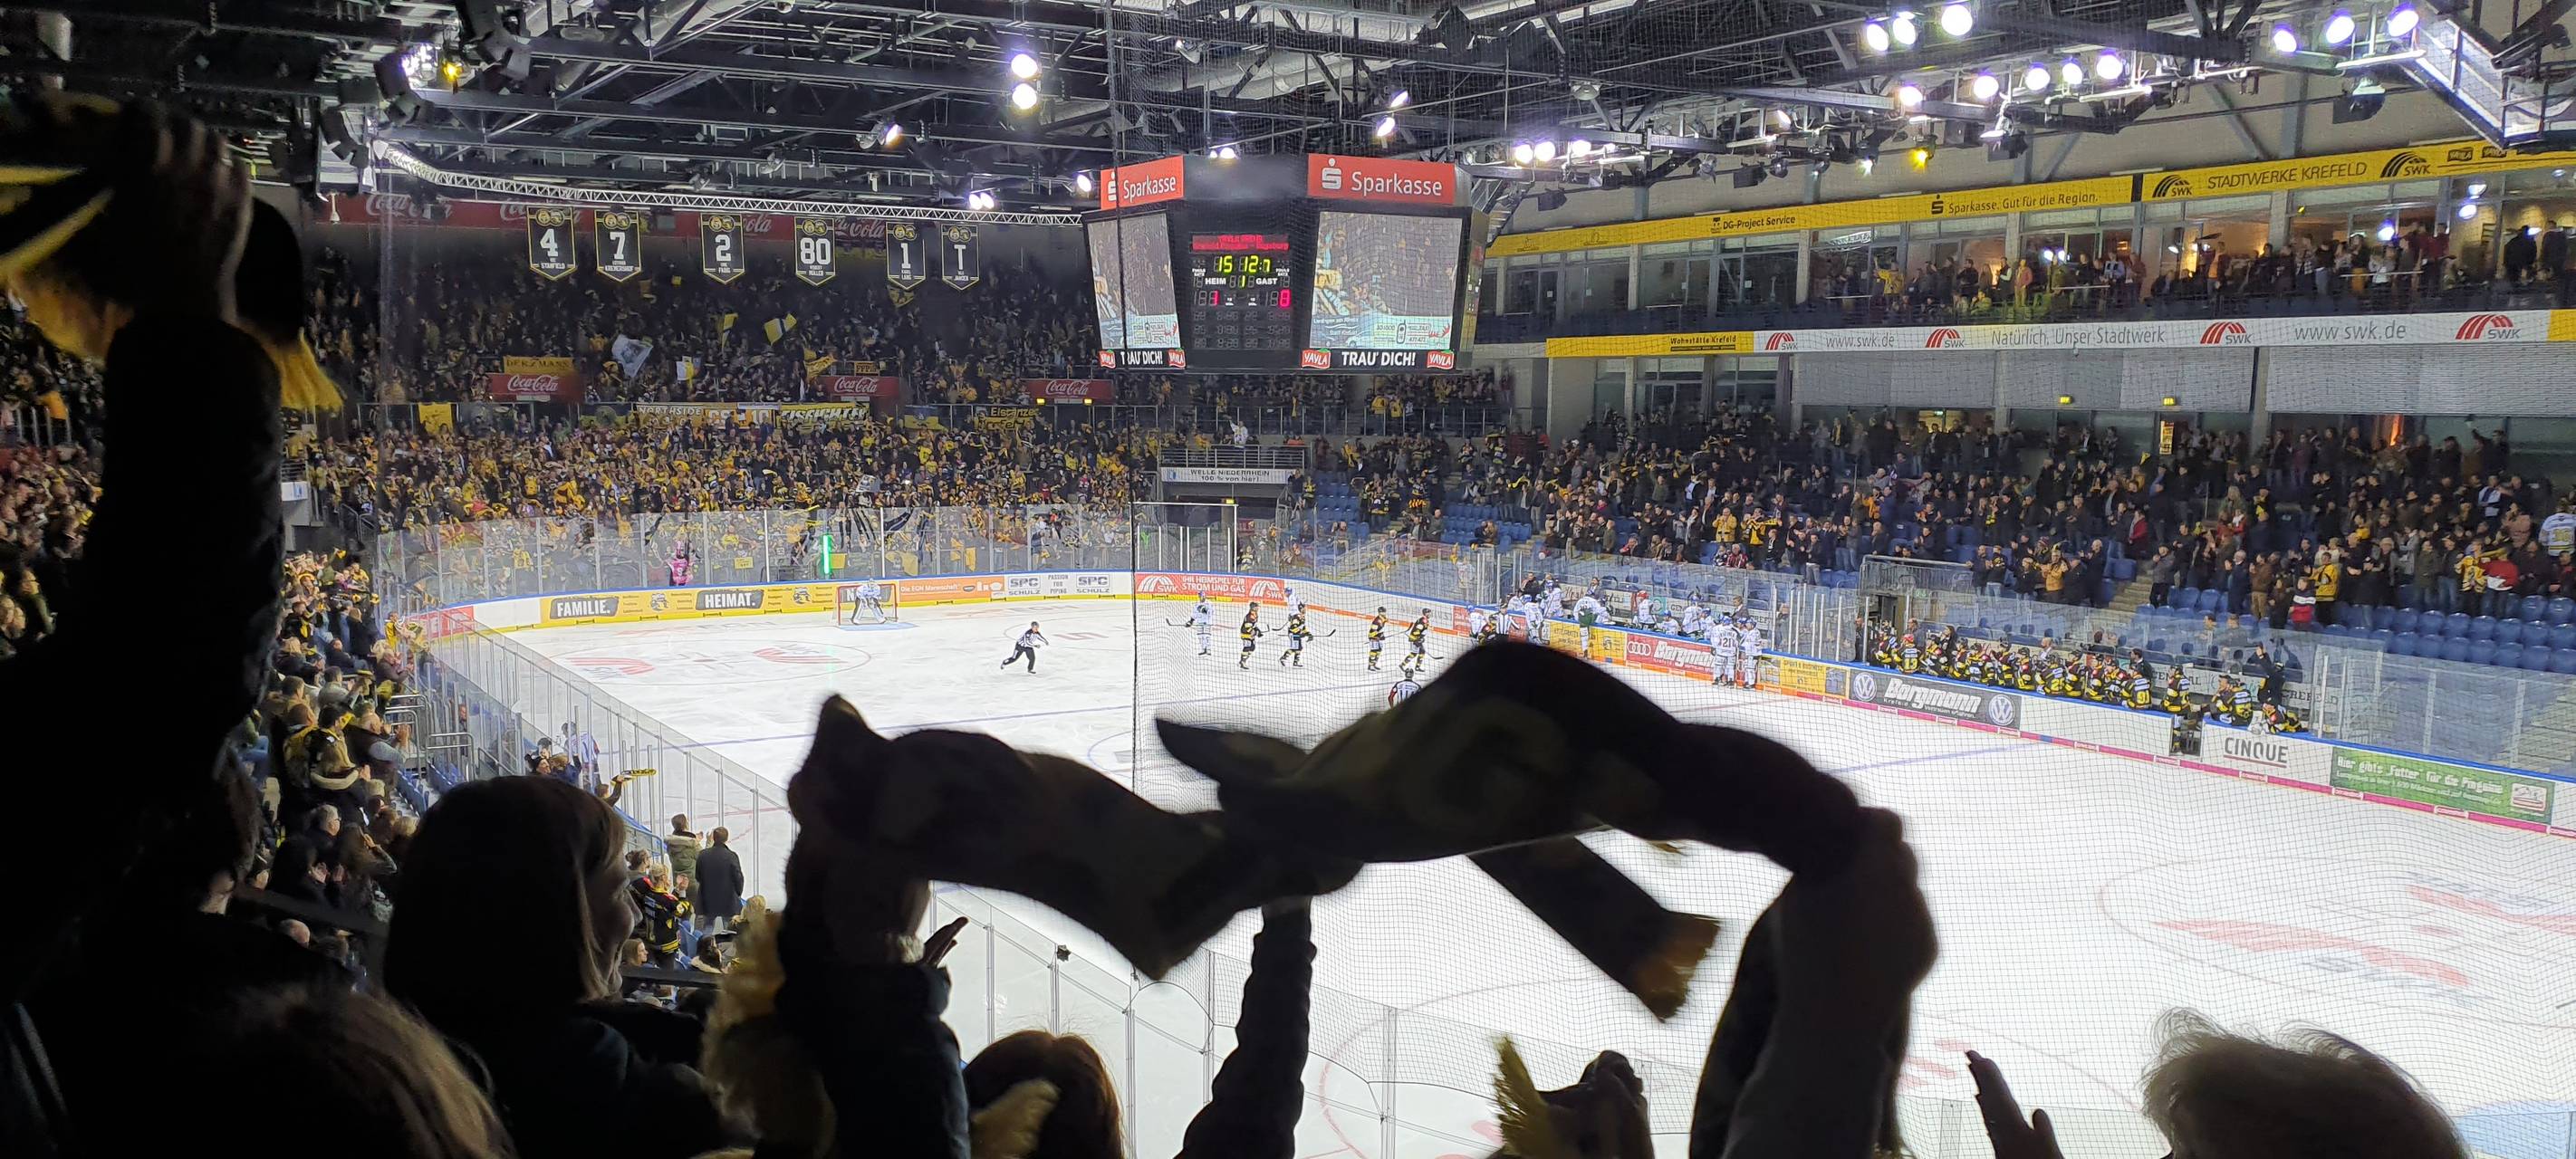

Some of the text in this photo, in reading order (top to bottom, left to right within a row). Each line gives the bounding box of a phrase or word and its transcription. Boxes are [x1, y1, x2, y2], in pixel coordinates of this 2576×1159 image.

[2207, 162, 2368, 189] STADTWERKE KREFELD
[2405, 163, 2432, 176] SWK
[1123, 175, 1176, 203] Sparkasse
[1350, 171, 1442, 196] Sparkasse
[2171, 187, 2193, 196] SWK
[1948, 202, 2000, 216] Sparkasse.
[2003, 198, 2019, 210] Gut
[2021, 196, 2037, 209] für
[2039, 194, 2056, 206] die
[2058, 192, 2099, 207] Region.
[1723, 218, 1764, 231] DG-Project
[1766, 215, 1796, 226] Service
[540, 228, 559, 257] 4
[610, 231, 626, 260] 7
[715, 234, 732, 262] 2
[800, 237, 831, 265] 80
[900, 243, 912, 269] 1
[954, 244, 966, 270] T
[1218, 255, 1233, 273] 15
[2055, 329, 2091, 346] Unser
[2097, 326, 2165, 345] Stadtwerk
[2295, 320, 2407, 340] www.swk.de
[2487, 328, 2523, 340] SWK
[1670, 334, 1737, 345] Wohnstätte Krefeld
[1781, 342, 1798, 351] SWK
[1826, 332, 1895, 349] www.swk.de
[1945, 340, 1965, 349] SWK
[2225, 334, 2254, 346] SWK
[1143, 350, 1163, 364] DICH!
[1304, 353, 1329, 365] YAYLA
[1381, 352, 1416, 367] DICH!
[1429, 352, 1452, 365] YAYLA
[639, 406, 702, 416] NORTHSIDE
[1011, 577, 1039, 587] SPC
[1078, 576, 1108, 586] SPC
[1182, 583, 1210, 591] STROM
[1197, 577, 1230, 585] HEIMSPIEL
[1232, 576, 1245, 585] FÜR
[1158, 585, 1177, 593] SWK
[1265, 591, 1284, 599] SWK
[557, 599, 610, 617] FAMILIE.
[705, 592, 756, 609] HEIMAT.
[1885, 678, 1982, 714] Borgmann
[2225, 737, 2289, 763] CINQUE
